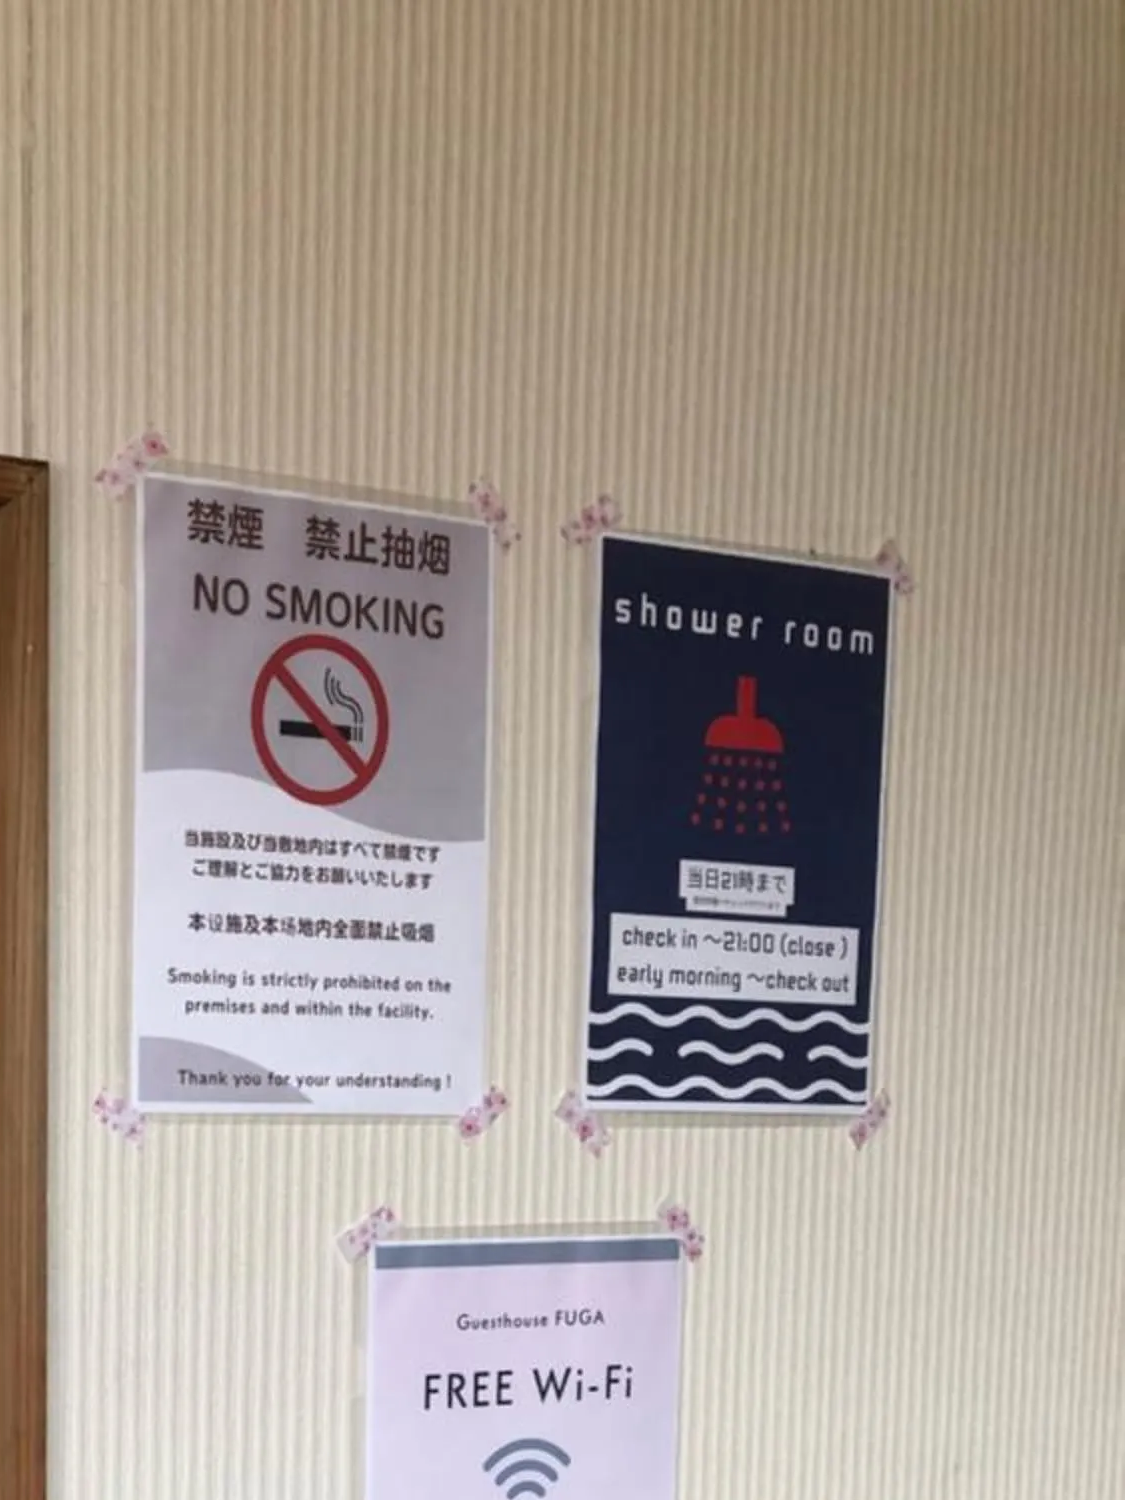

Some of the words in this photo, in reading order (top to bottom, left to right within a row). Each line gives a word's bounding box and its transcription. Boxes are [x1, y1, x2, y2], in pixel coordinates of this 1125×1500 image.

[187, 498, 265, 551] 禁煙
[305, 514, 451, 576] 禁止抽烟
[193, 573, 250, 617] NO
[265, 582, 445, 640] SMOKING
[615, 592, 763, 641] shower
[784, 621, 874, 655] room
[192, 858, 434, 890] ご理解とご協力をお願いいたします
[622, 926, 676, 948] check
[681, 928, 698, 949] in
[167, 967, 237, 989] Smoking
[242, 970, 256, 986] is
[261, 971, 319, 991] strictly
[323, 974, 400, 993] prohibited
[405, 978, 423, 992] on
[428, 977, 452, 993] the
[617, 964, 663, 988] early
[668, 967, 742, 992] morning
[822, 974, 849, 993] out
[185, 999, 256, 1015] premises
[261, 999, 290, 1015] and
[295, 1001, 343, 1016] within
[348, 1002, 372, 1017] the
[378, 1002, 434, 1021] facility.
[178, 1069, 228, 1086] Thank
[233, 1073, 262, 1089] you
[268, 1070, 291, 1087] for
[296, 1073, 331, 1089] your
[336, 1071, 442, 1090] understanding
[456, 1312, 548, 1331] Guesthouse
[554, 1308, 605, 1326] FUGA
[422, 1369, 513, 1411] FREE
[532, 1364, 634, 1403] Wi-Fi
